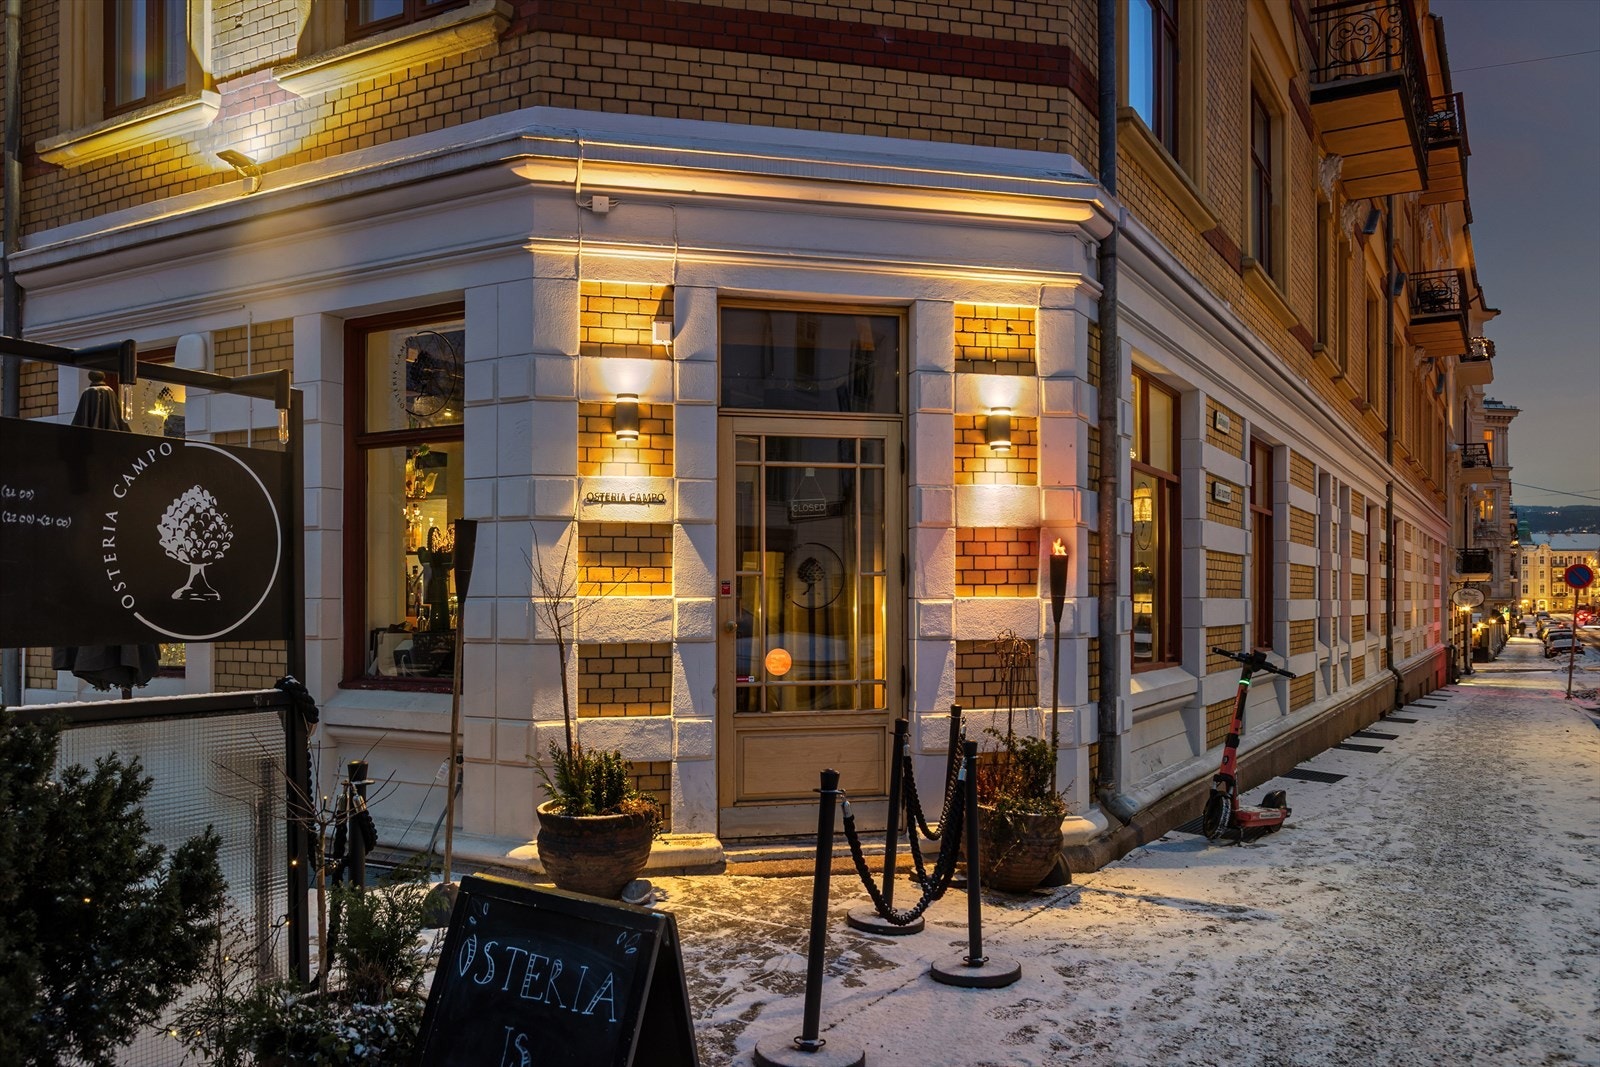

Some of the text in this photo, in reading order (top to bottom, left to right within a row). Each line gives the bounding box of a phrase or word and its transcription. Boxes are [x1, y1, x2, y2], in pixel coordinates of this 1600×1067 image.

[586, 491, 627, 503] OSTERIA
[791, 503, 826, 513] CLOSED
[102, 442, 173, 609] OSTERIA CAMPO
[459, 934, 617, 1023] OSTERIA
